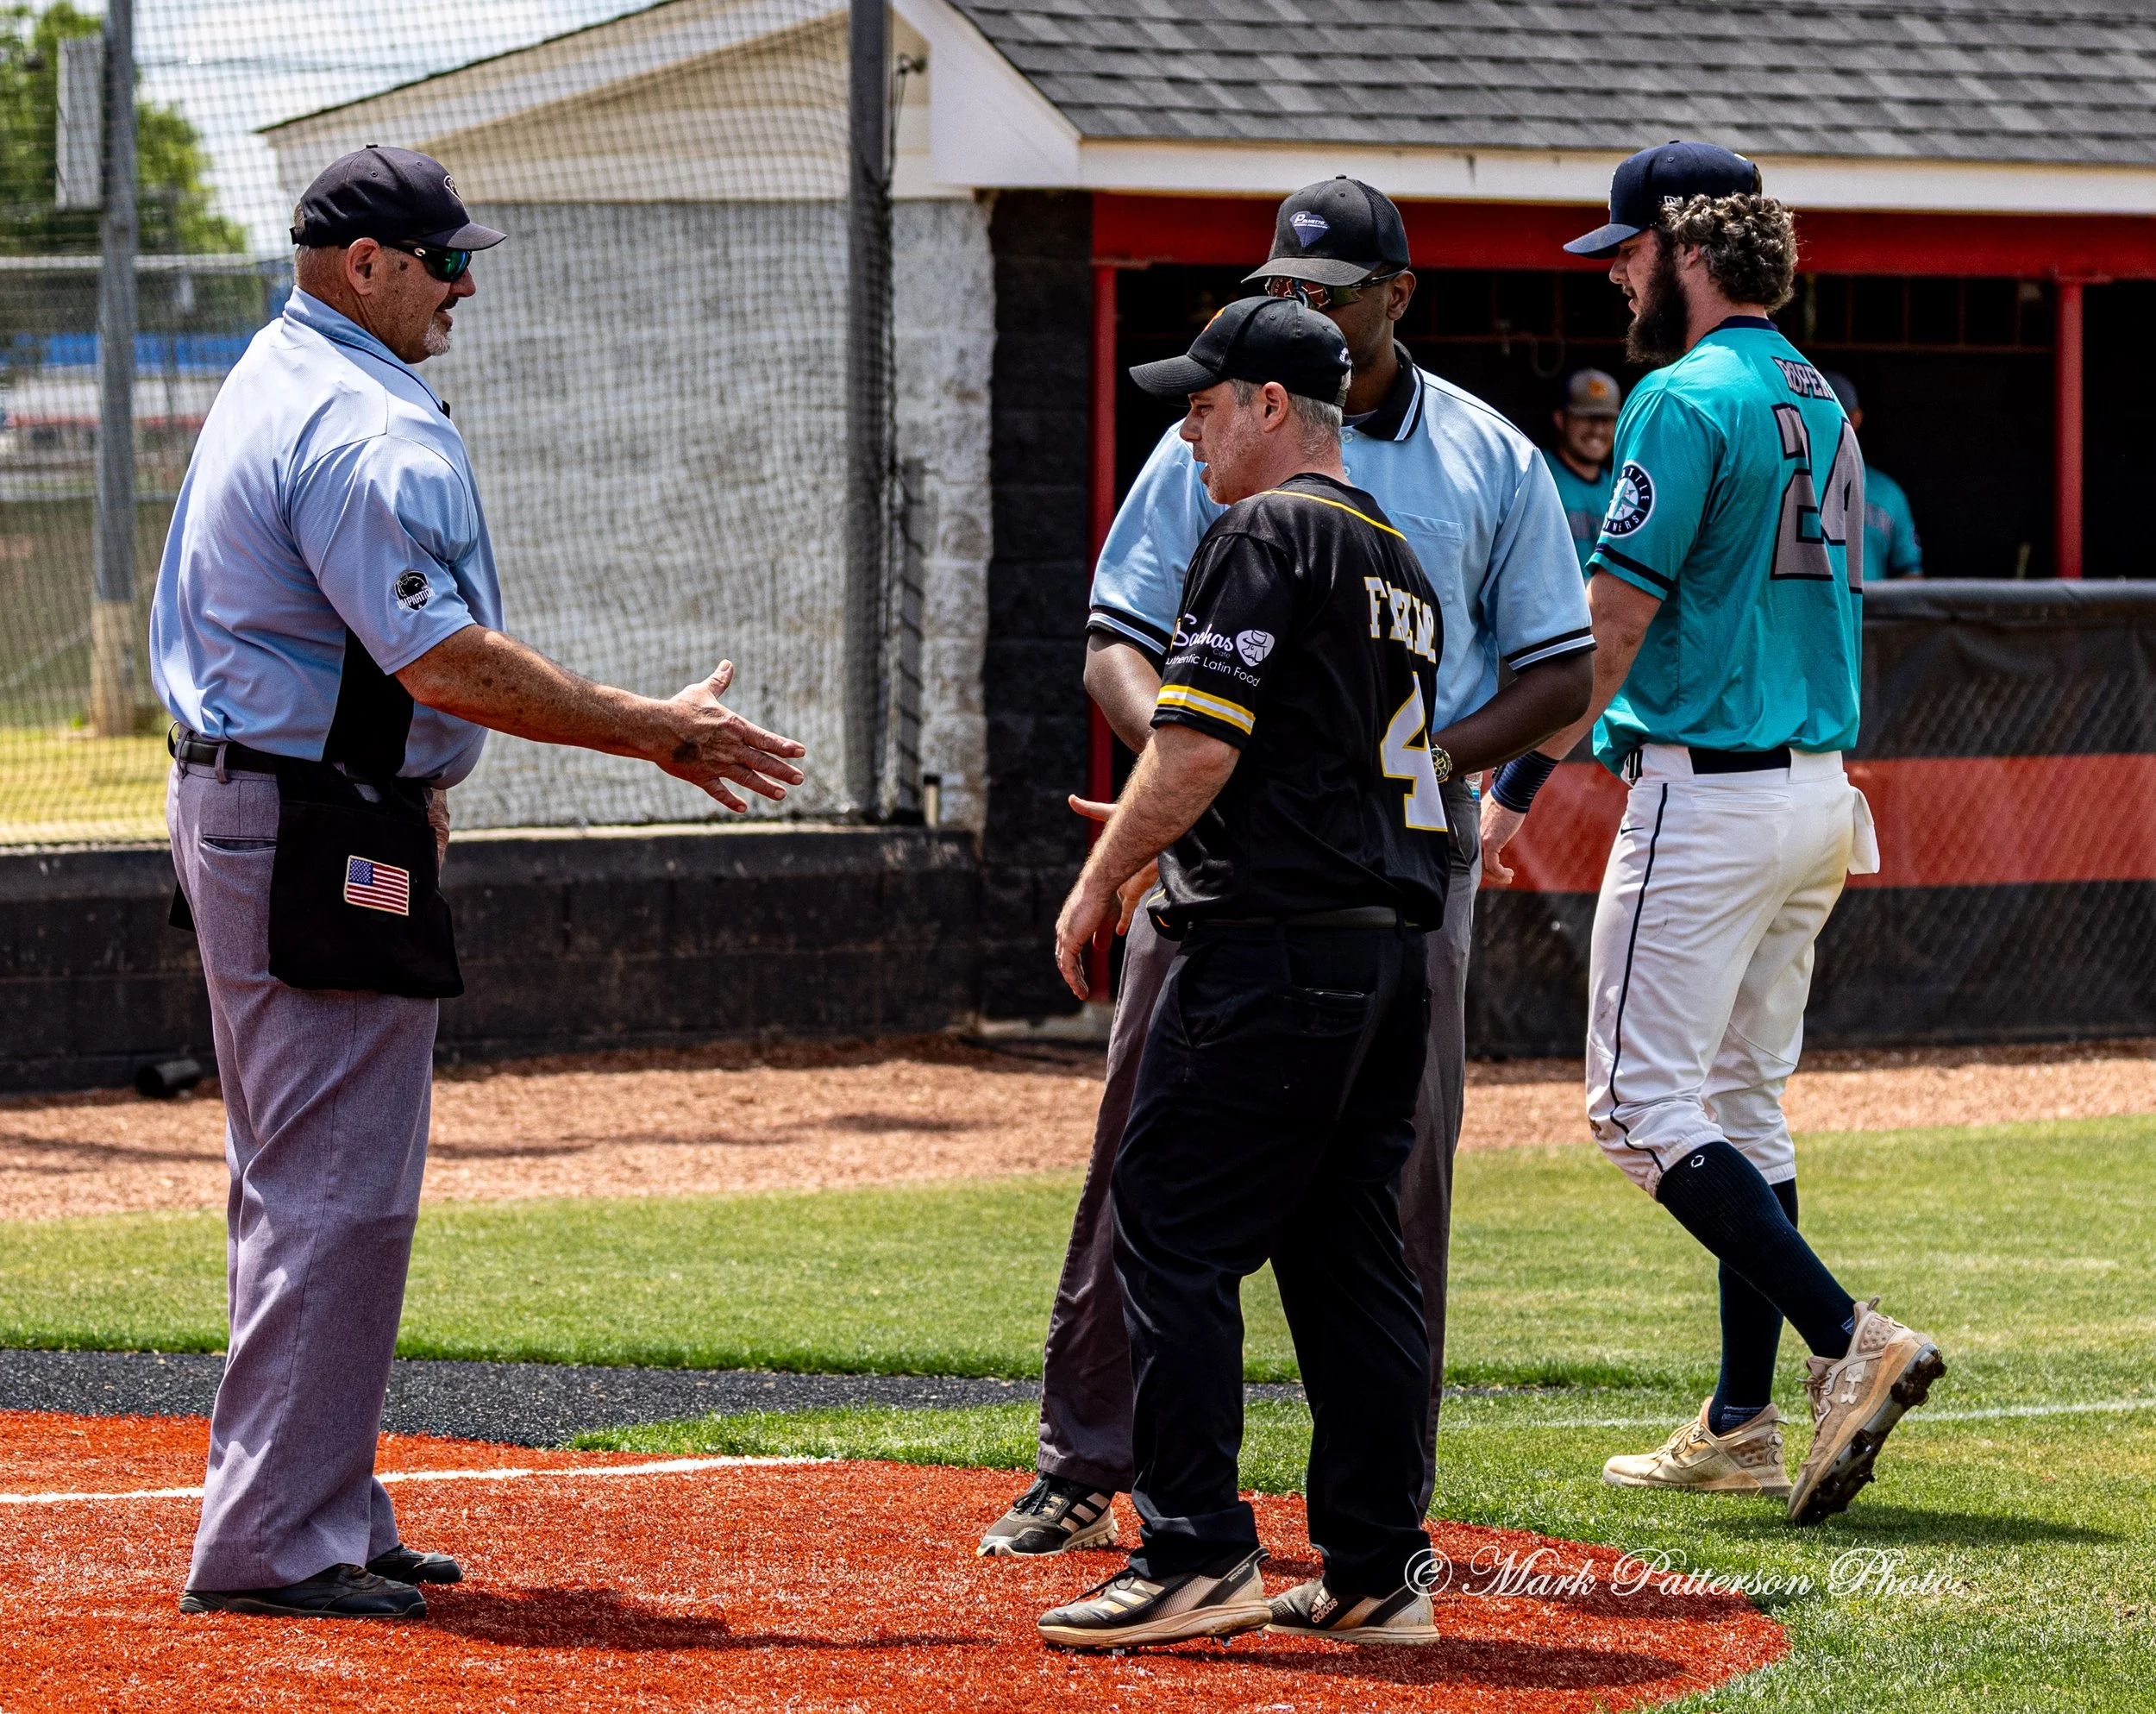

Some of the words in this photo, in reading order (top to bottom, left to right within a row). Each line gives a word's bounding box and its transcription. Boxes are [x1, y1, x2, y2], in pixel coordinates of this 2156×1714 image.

[1771, 402, 1865, 595] 24
[1202, 656, 1232, 675] Latin
[1233, 667, 1261, 687] Food
[1380, 671, 1449, 832] 4
[1311, 1598, 1338, 1623] adidas
